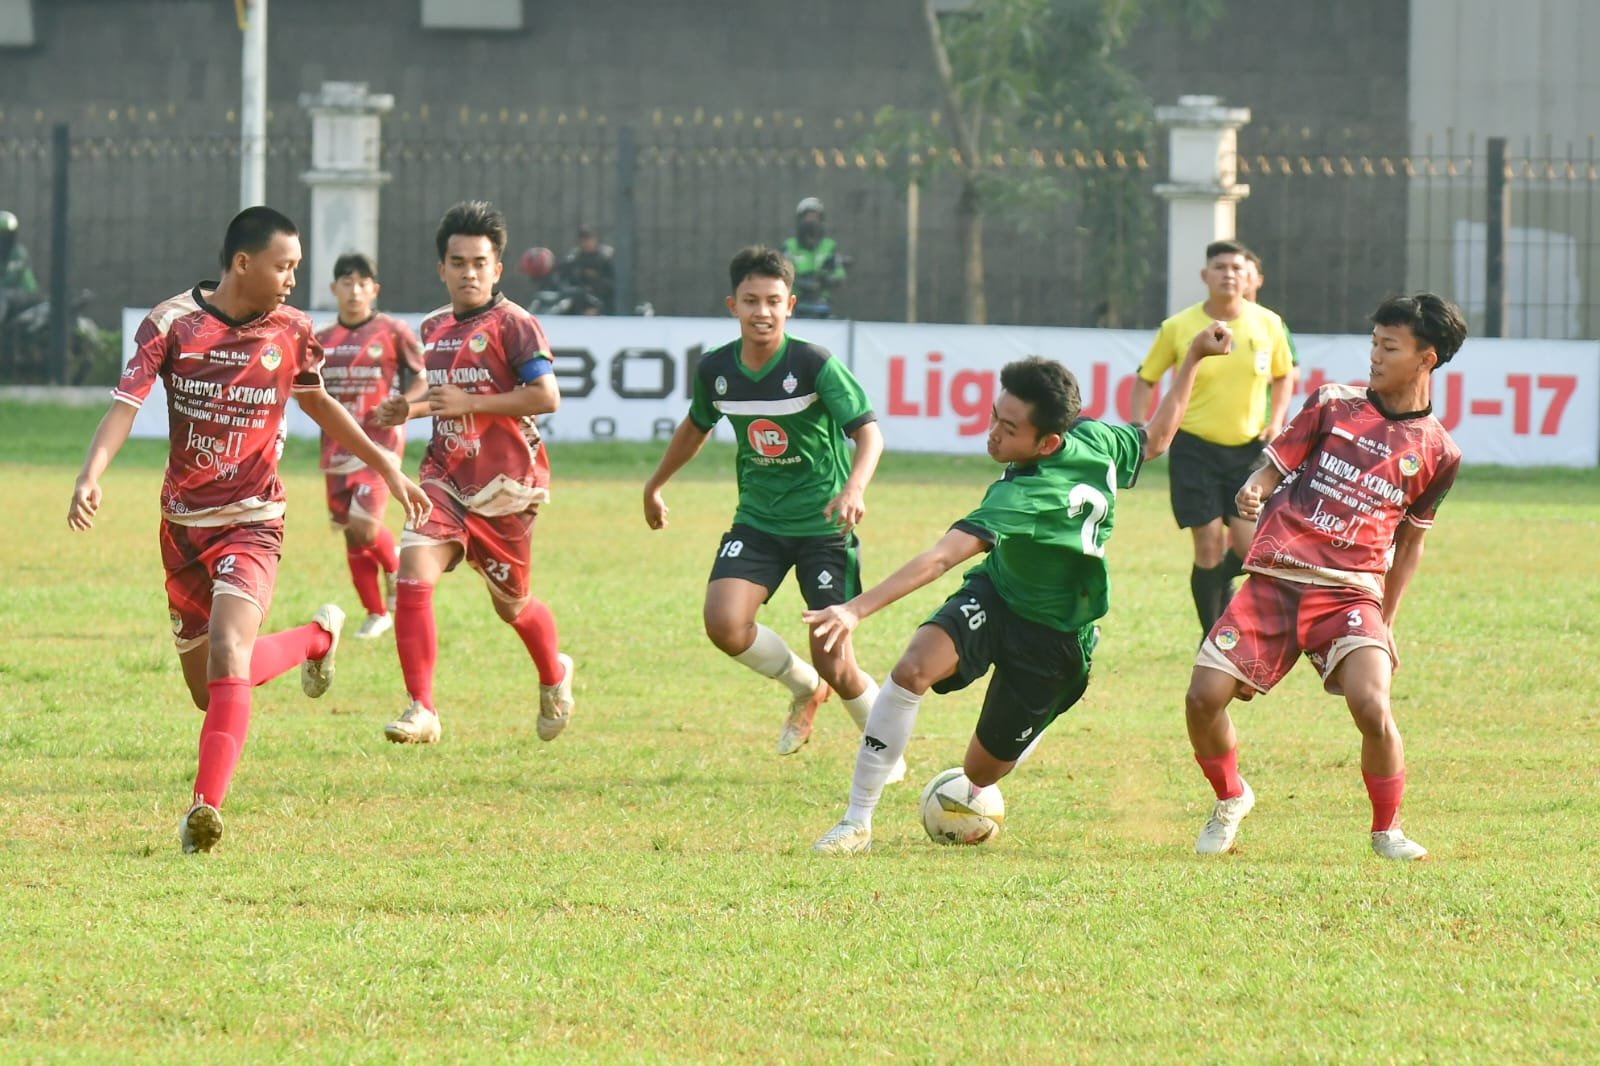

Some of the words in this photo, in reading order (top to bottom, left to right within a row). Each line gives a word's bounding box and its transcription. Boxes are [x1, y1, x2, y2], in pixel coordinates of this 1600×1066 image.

[171, 372, 222, 400] TARUMA
[227, 385, 277, 405] SCHOOL
[888, 351, 994, 436] Lig
[174, 401, 213, 421] BOARDING
[213, 413, 231, 425] AND
[232, 416, 250, 428] FULL
[752, 430, 787, 451] NR
[1319, 450, 1360, 483] ARUMA
[1341, 494, 1359, 508] AND
[719, 540, 743, 558] 19
[486, 557, 512, 581] 23
[959, 597, 987, 631] 26
[1347, 609, 1363, 626] 3
